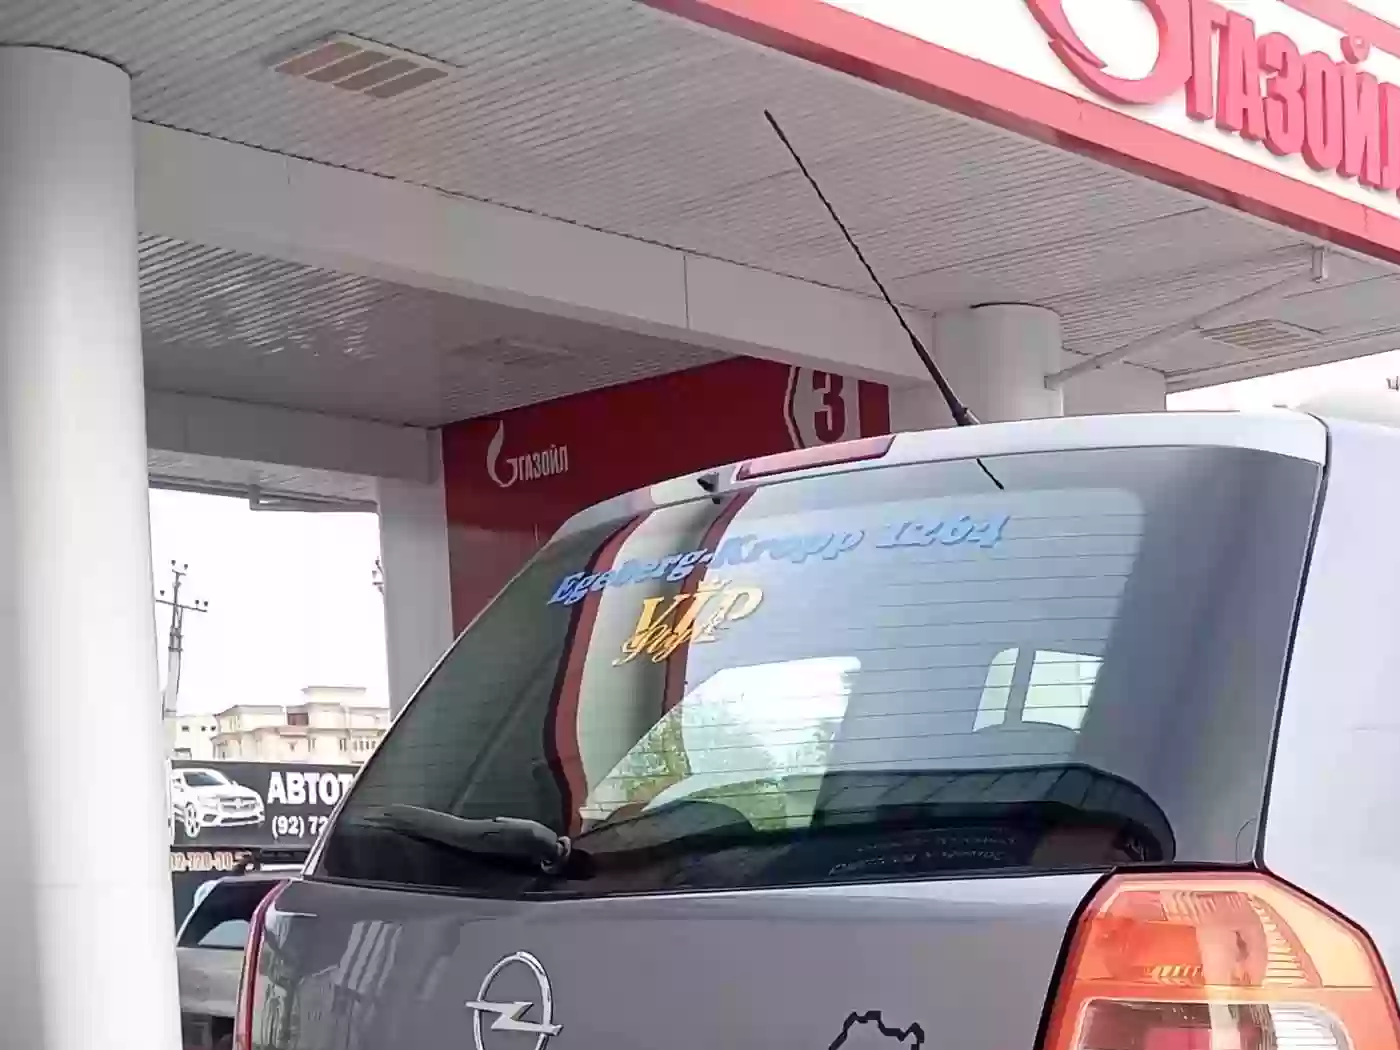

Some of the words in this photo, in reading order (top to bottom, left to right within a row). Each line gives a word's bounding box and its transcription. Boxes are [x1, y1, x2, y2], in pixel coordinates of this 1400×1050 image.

[812, 370, 846, 443] 3
[518, 443, 569, 481] ГАЗОЙЛ
[271, 815, 305, 840] (92)
